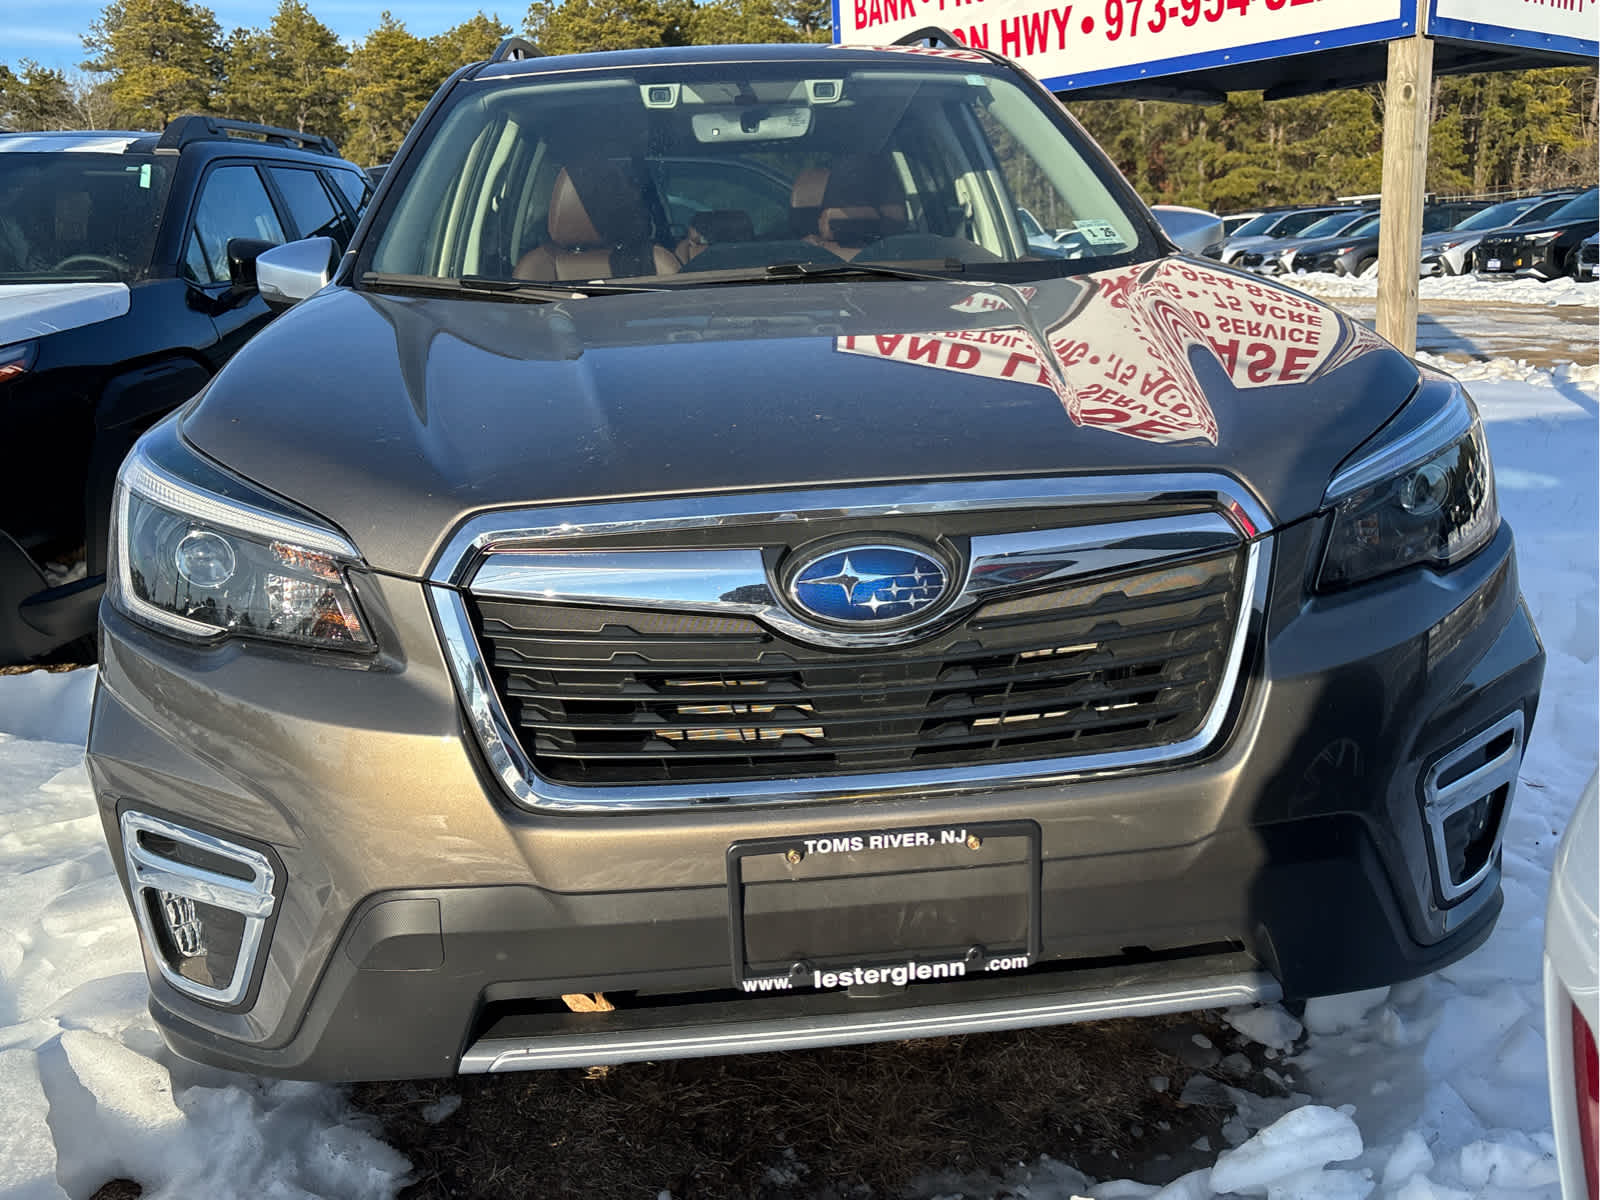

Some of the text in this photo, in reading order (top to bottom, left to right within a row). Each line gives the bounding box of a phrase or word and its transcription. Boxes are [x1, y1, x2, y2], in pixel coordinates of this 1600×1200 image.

[1000, 4, 1073, 59] HWY
[803, 829, 967, 855] TOMS RIVER, NJ
[742, 956, 1029, 993] www. lesterglenn .com
